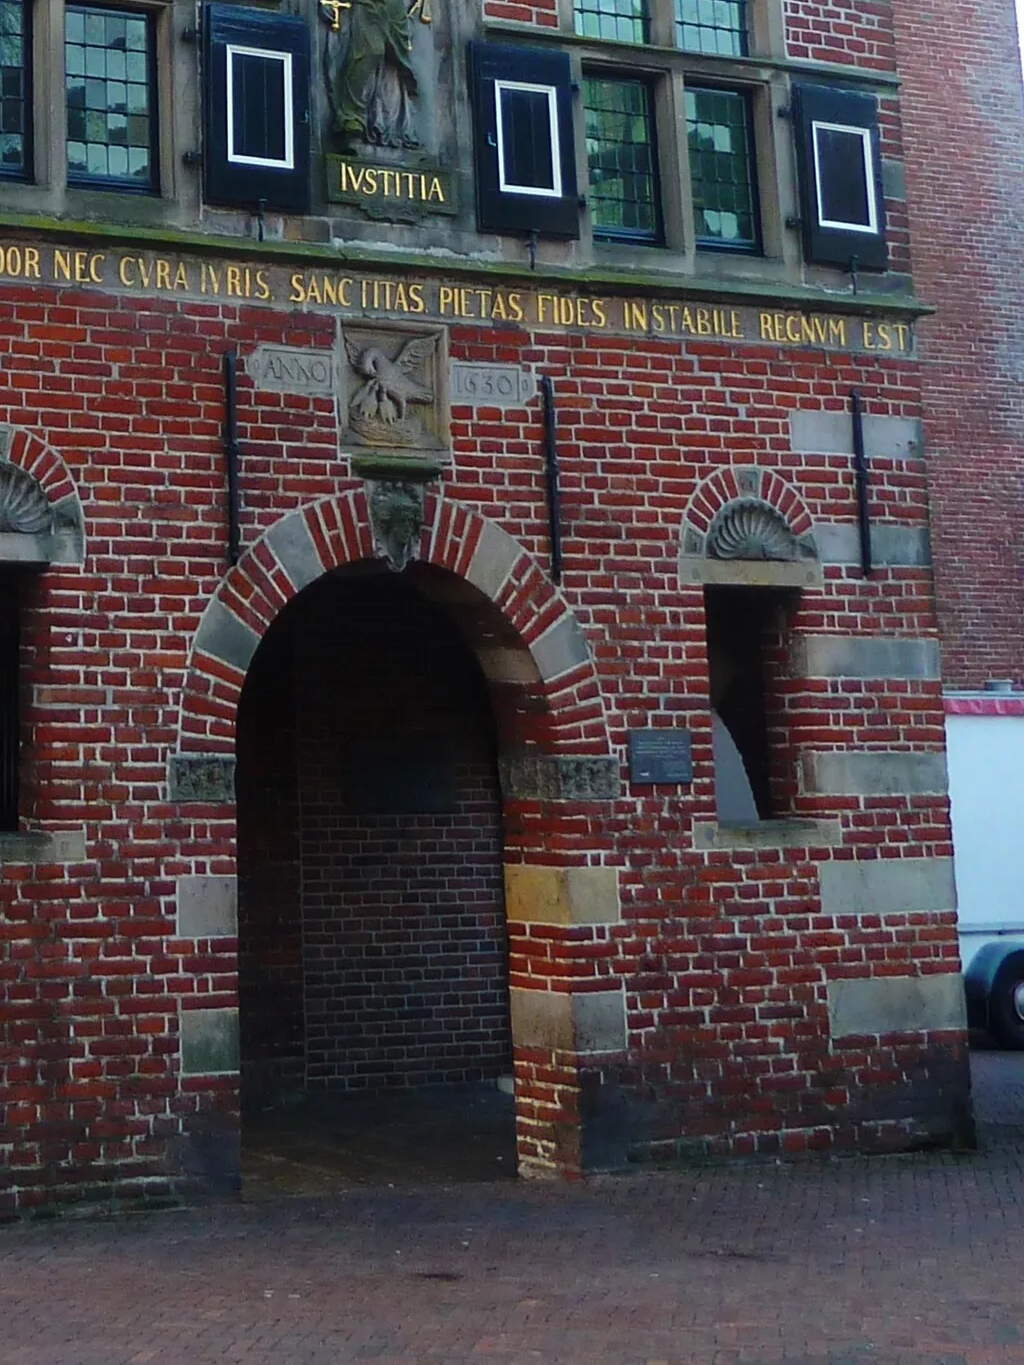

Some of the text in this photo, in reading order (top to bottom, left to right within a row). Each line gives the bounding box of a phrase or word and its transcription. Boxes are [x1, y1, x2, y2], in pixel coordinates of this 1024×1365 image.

[340, 162, 445, 202] IVSTITIA
[54, 249, 106, 284] NEC
[119, 256, 190, 292] CVRA
[200, 263, 276, 302] IVRIS.
[623, 301, 745, 338] INSTABILE
[759, 312, 846, 347] REGNVM
[863, 321, 908, 351] EST
[263, 358, 514, 394] ANNO 1630
